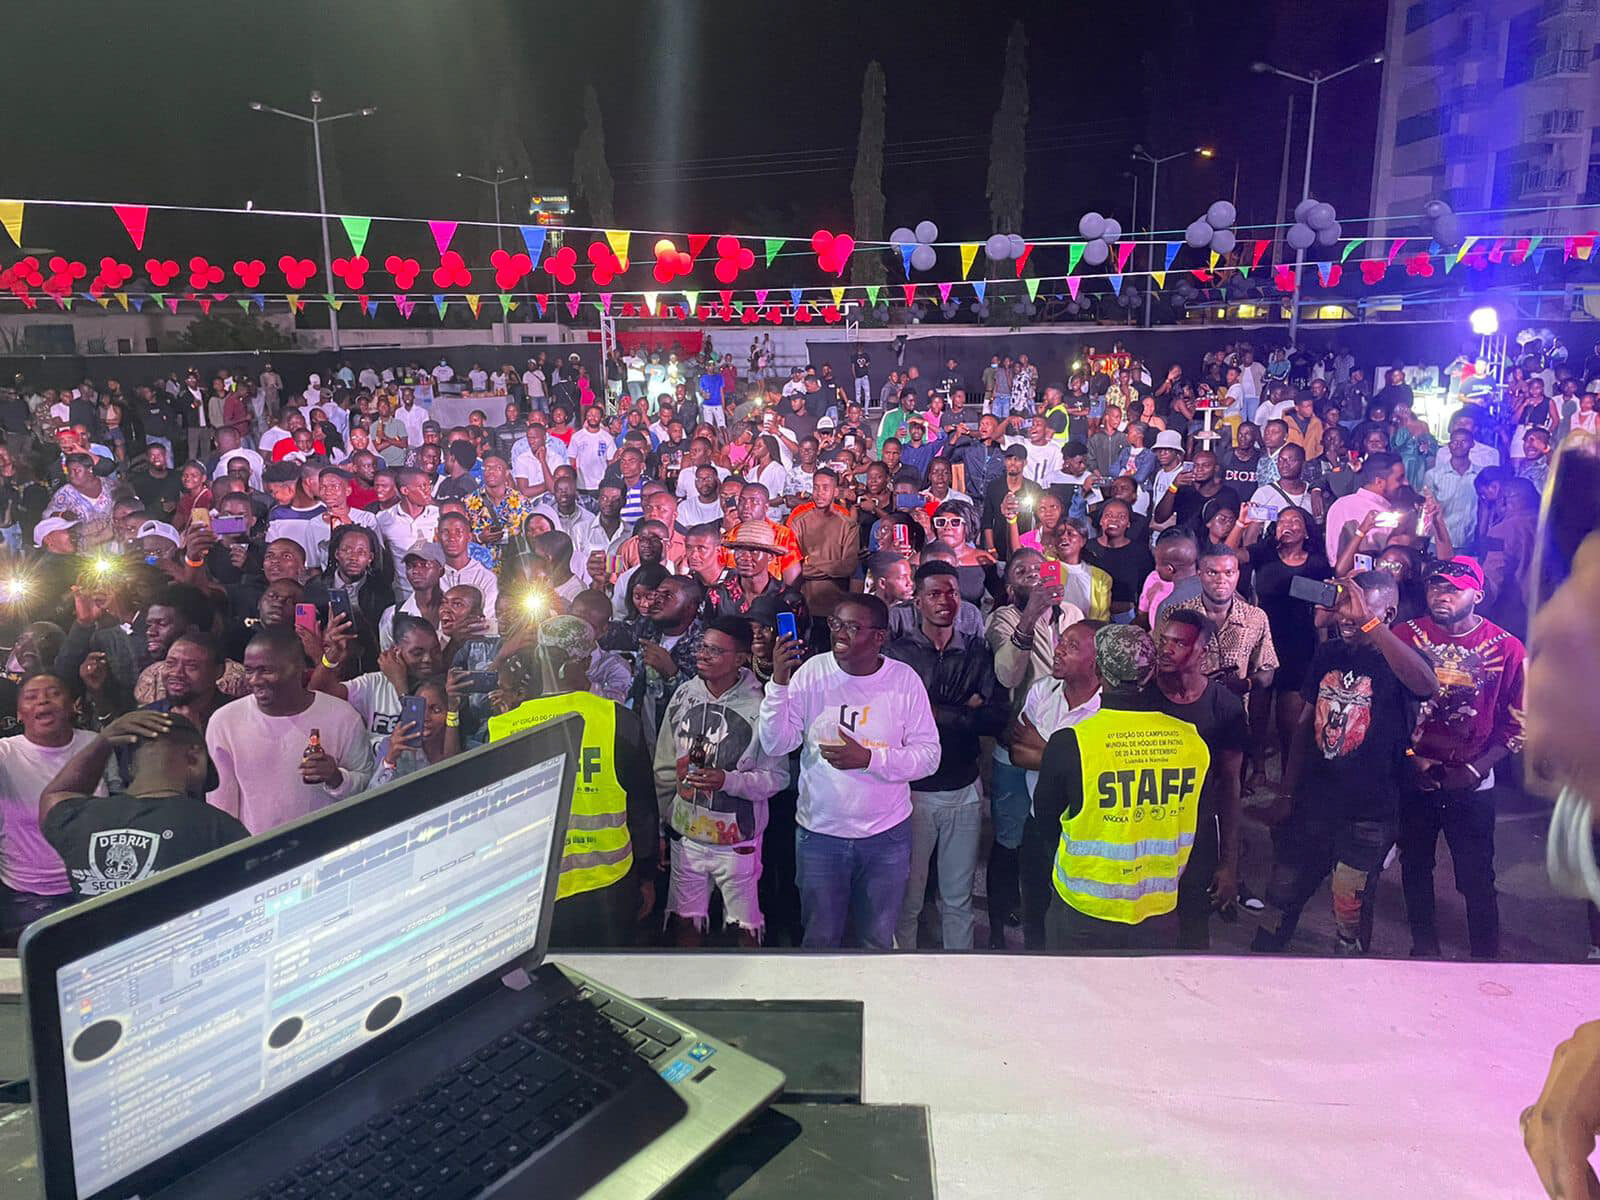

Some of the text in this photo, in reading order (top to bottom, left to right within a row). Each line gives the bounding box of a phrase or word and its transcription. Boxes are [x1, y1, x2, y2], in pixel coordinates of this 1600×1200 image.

[1150, 747, 1177, 755] SETEMBRO
[1098, 768, 1195, 808] STAFF
[99, 834, 149, 849] DEBRIX
